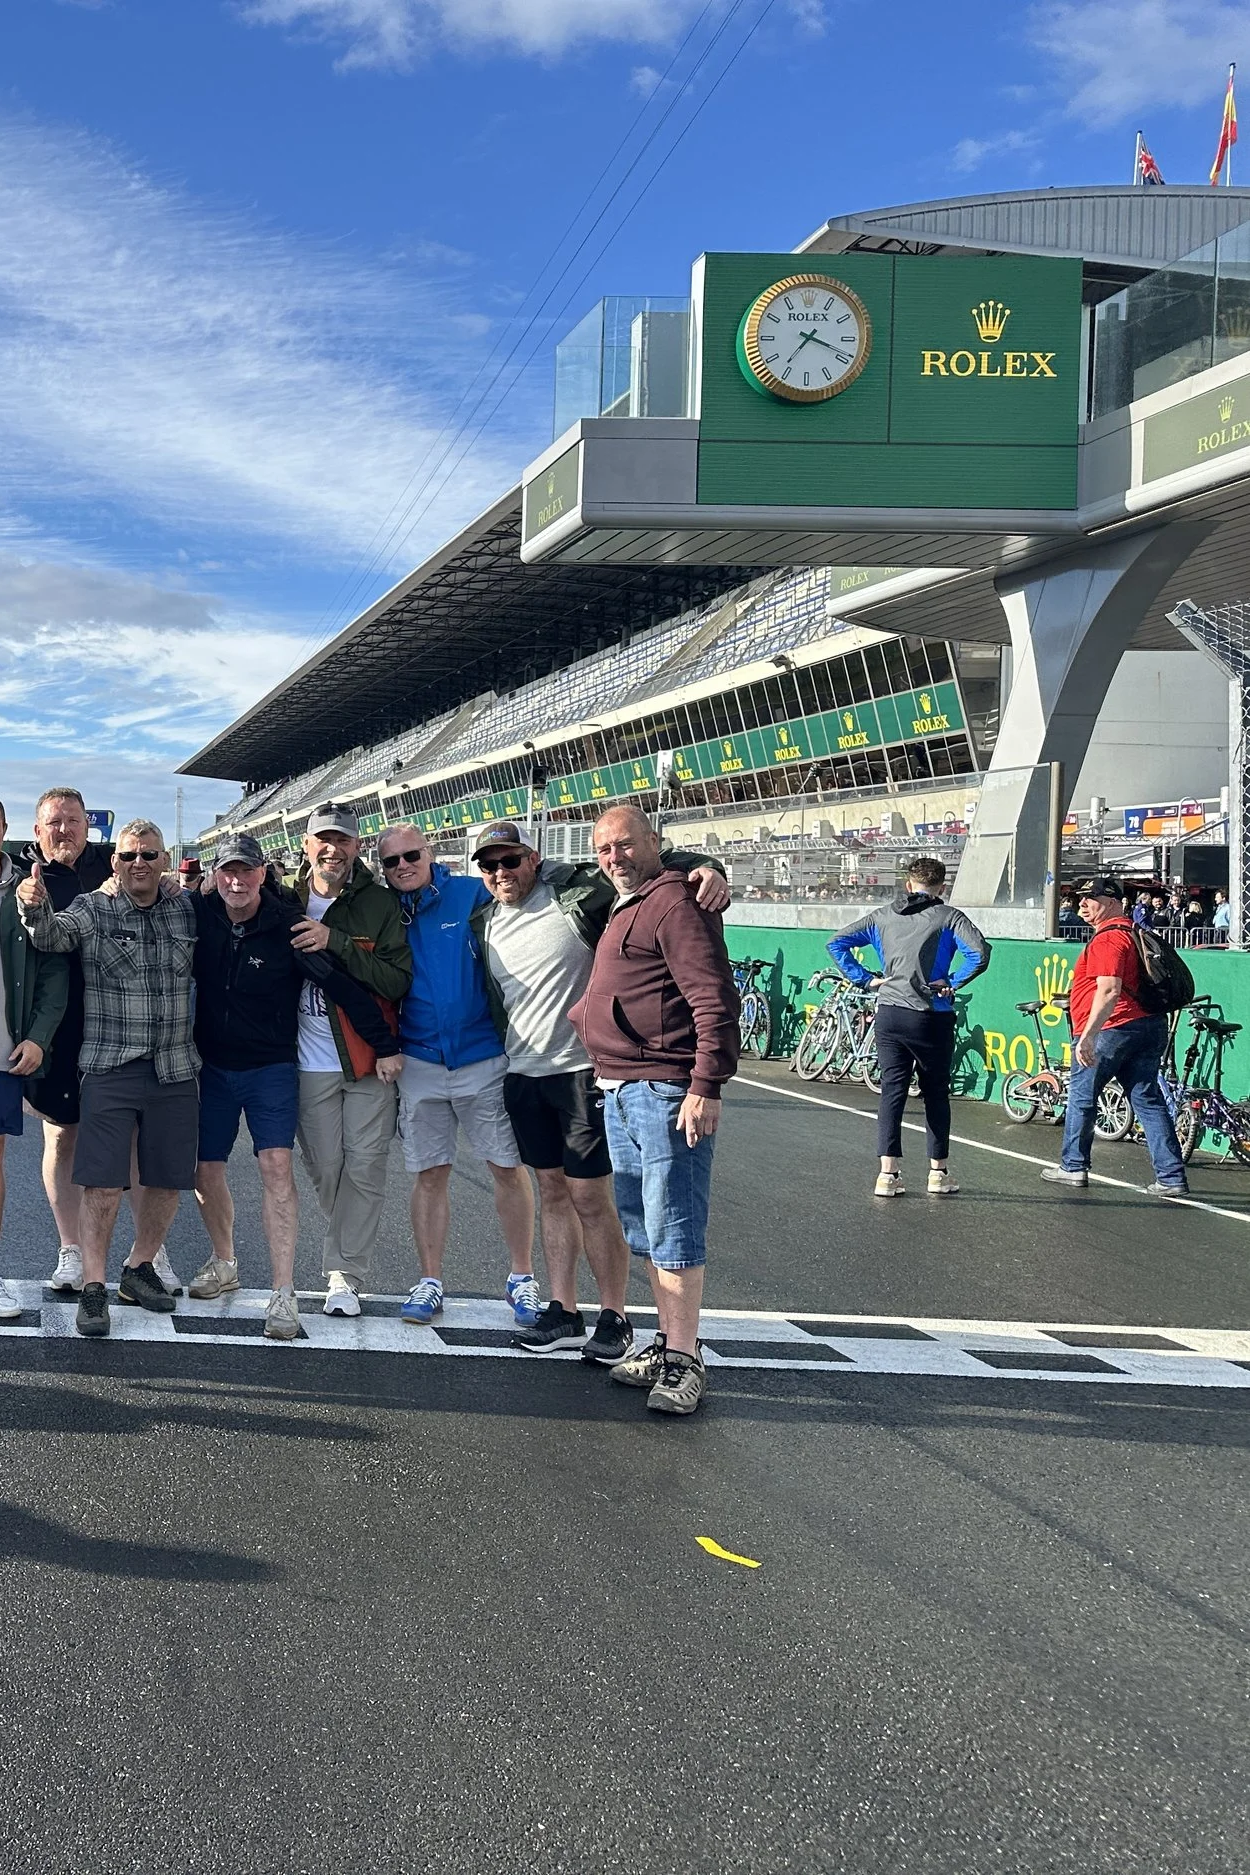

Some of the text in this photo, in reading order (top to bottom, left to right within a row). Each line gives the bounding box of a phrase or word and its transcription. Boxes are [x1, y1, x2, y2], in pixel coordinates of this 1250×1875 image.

[788, 312, 829, 322] ROLEX
[920, 350, 1057, 378] ROLEX
[840, 571, 869, 591] ROLEX
[911, 714, 951, 734] ROLEX
[837, 731, 871, 750] ROLEX
[774, 745, 802, 762] ROLEX
[720, 757, 745, 773] ROLEX
[676, 768, 694, 781] OLEX
[1128, 816, 1140, 829] 78
[945, 834, 958, 844] 78
